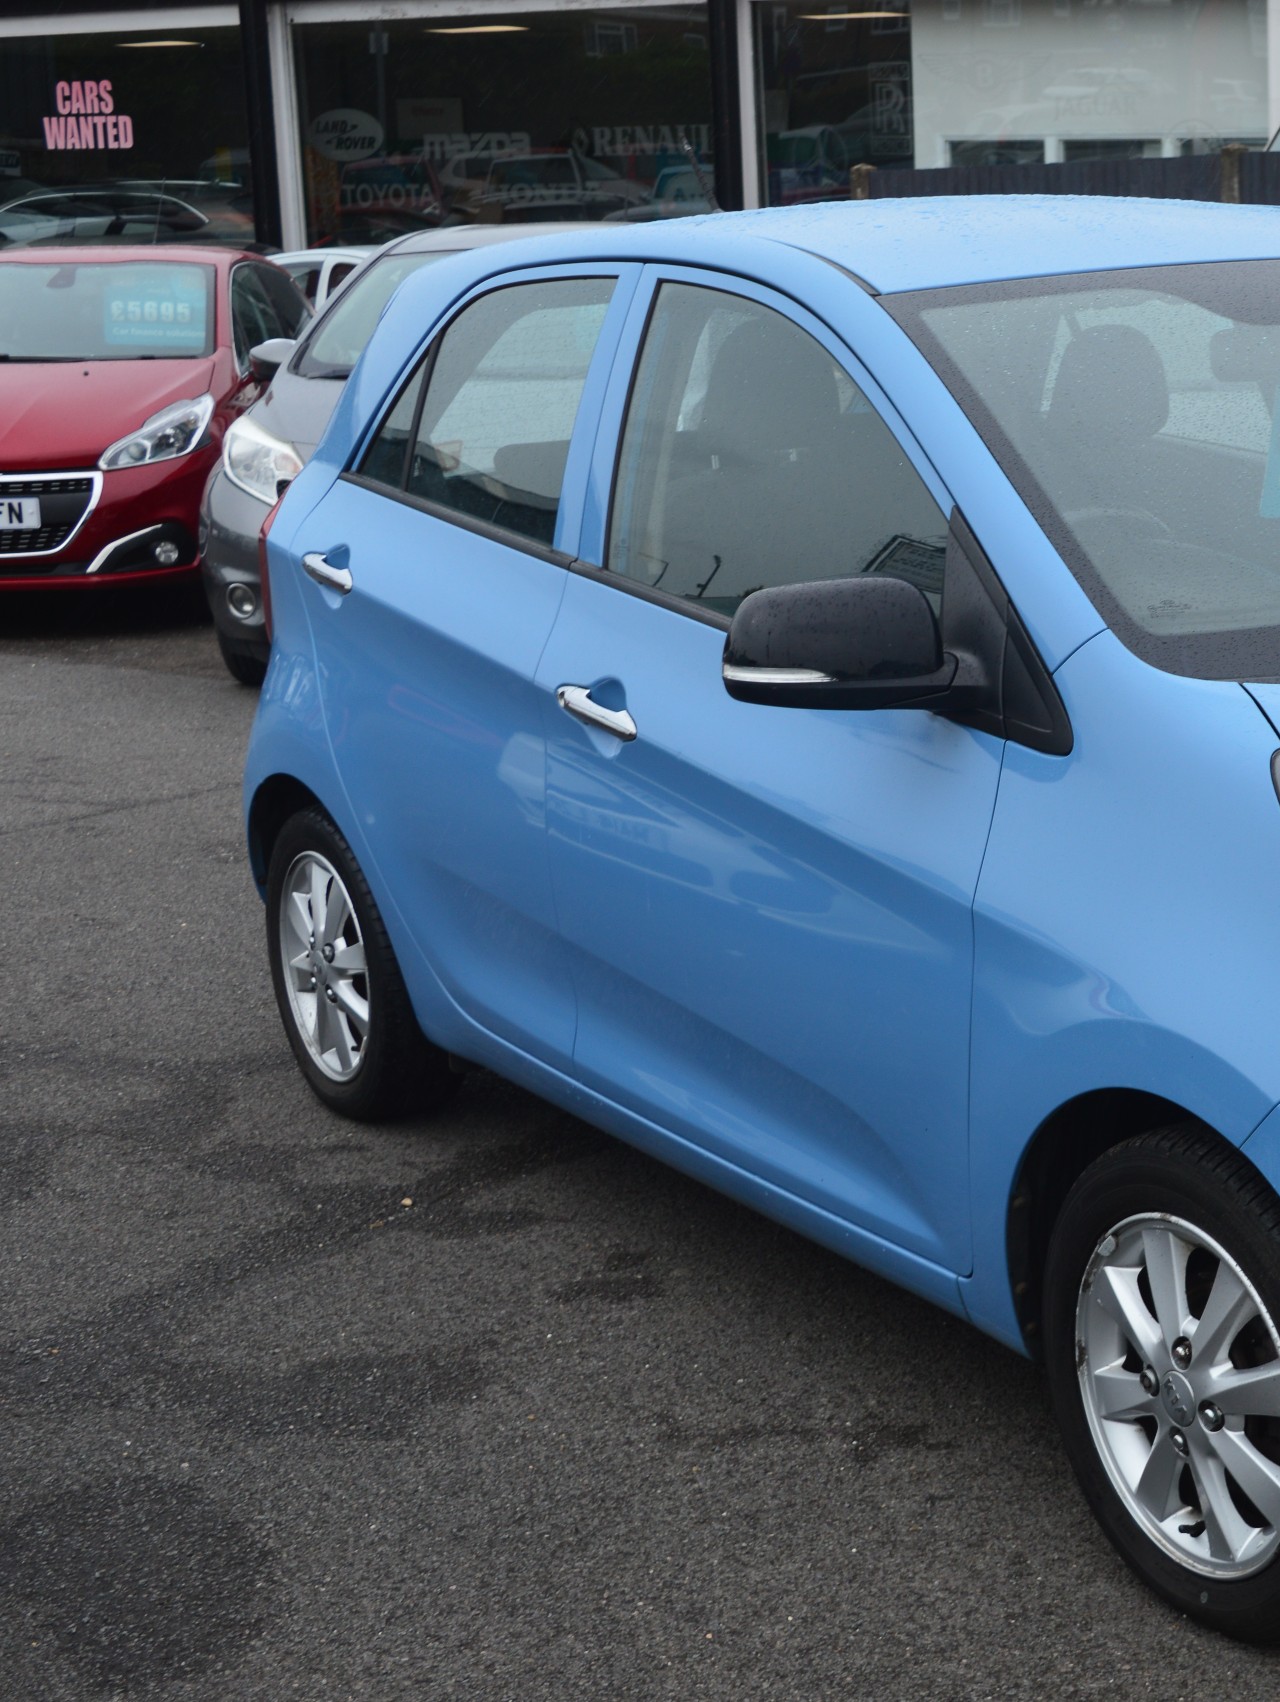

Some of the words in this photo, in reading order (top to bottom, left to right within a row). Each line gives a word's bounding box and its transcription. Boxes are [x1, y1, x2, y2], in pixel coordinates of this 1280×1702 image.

[56, 80, 113, 114] CARS
[43, 115, 133, 150] WANTED
[335, 136, 376, 150] ROVER
[342, 184, 434, 207] TOYOTA
[110, 300, 192, 323] £5695
[0, 502, 23, 523] N
[1164, 1376, 1188, 1419] KIA
